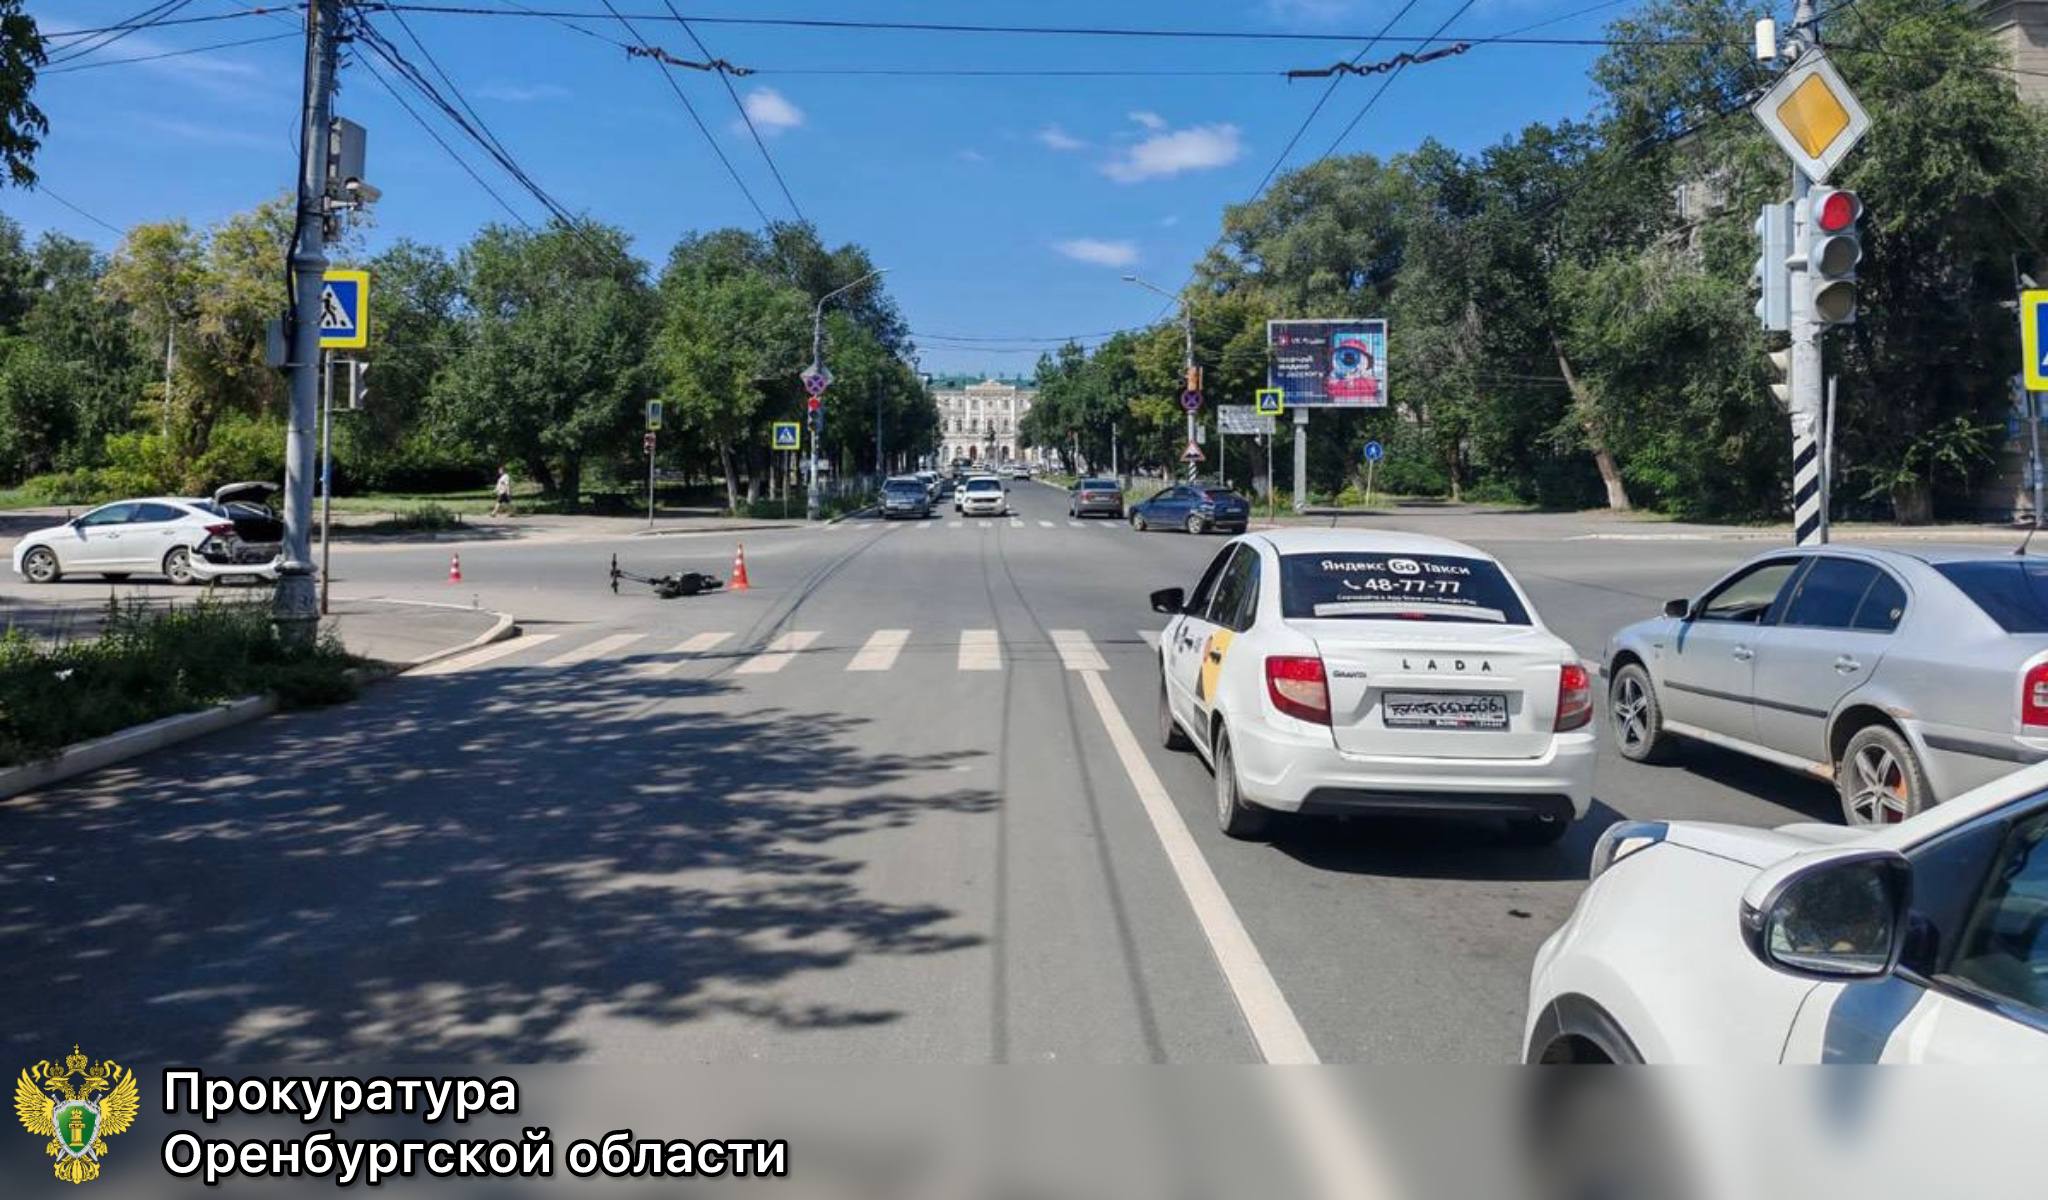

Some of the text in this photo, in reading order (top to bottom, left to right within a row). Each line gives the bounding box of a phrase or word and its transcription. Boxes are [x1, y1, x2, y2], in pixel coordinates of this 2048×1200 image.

[1321, 559, 1471, 576] Яндекс Go Такси
[1364, 578, 1460, 593] 48-77-77
[1402, 659, 1491, 672] LADA
